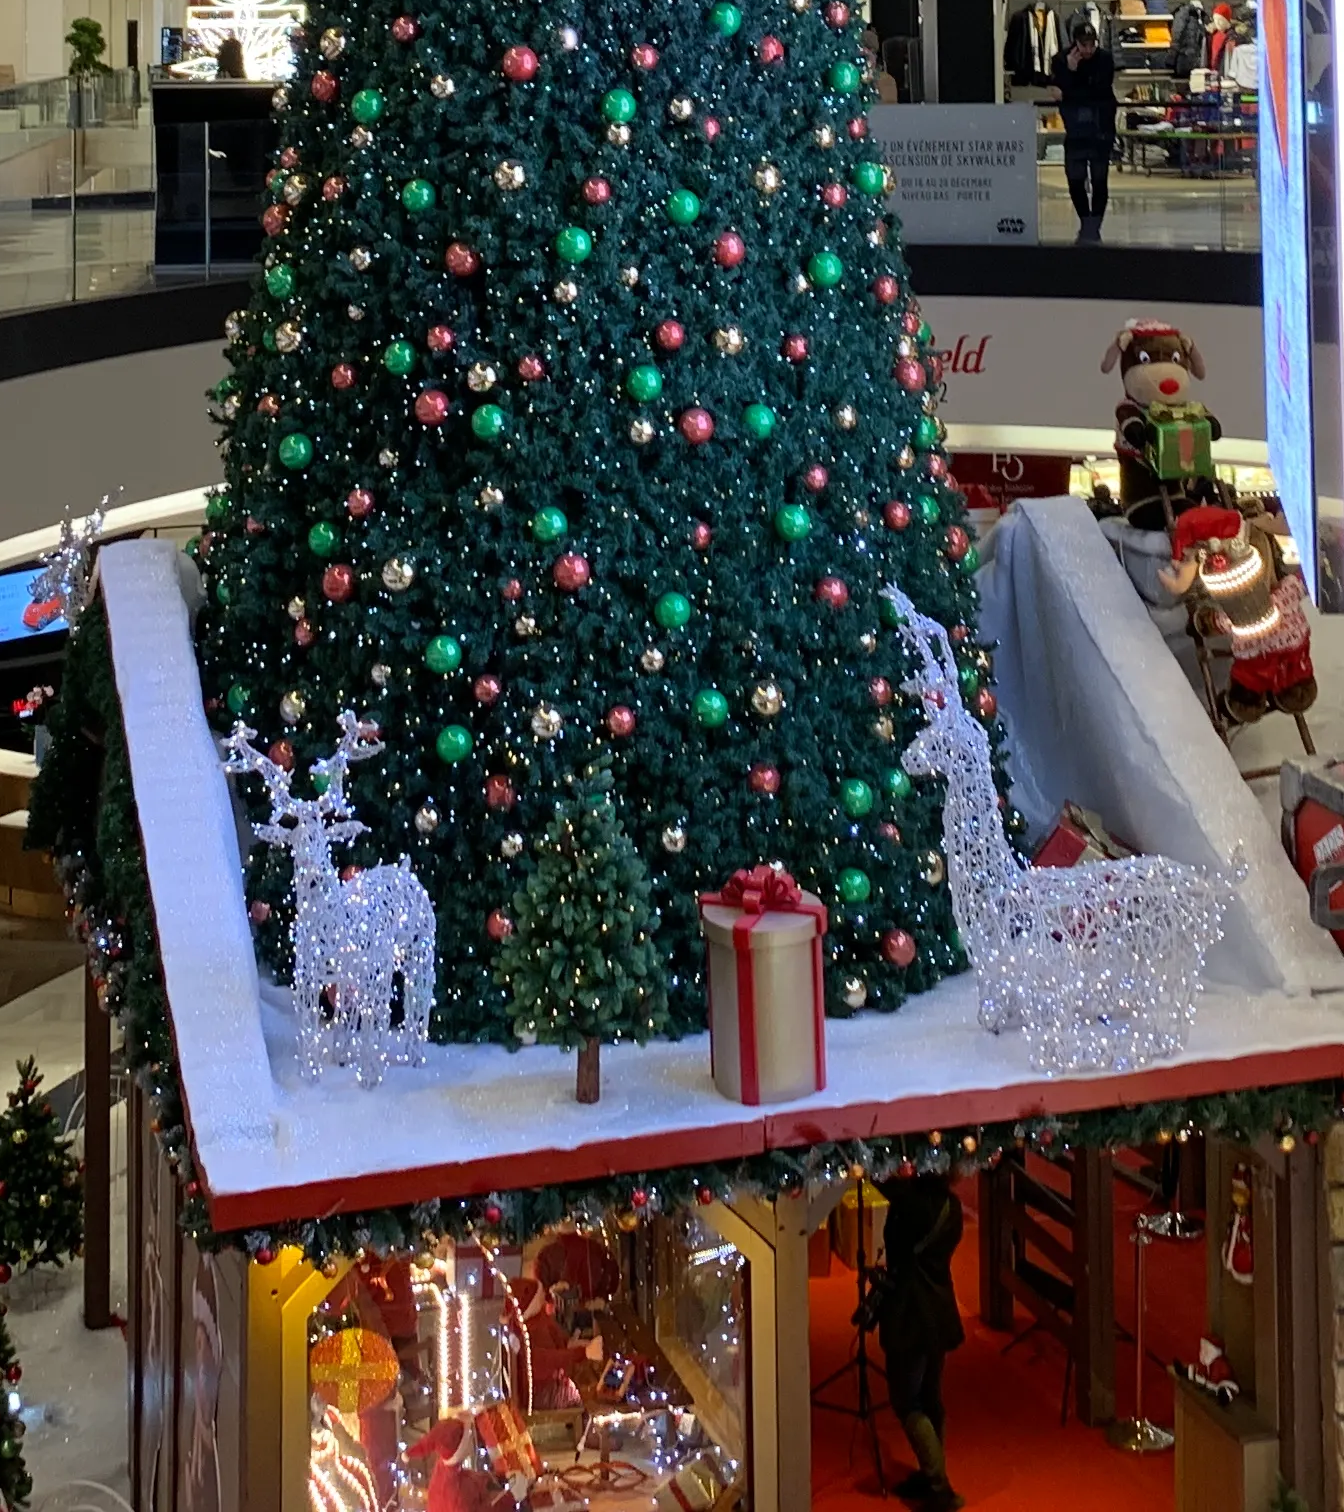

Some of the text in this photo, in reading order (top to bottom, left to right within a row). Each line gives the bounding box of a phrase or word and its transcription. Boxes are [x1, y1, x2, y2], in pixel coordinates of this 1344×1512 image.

[968, 141, 993, 153] STAR
[995, 141, 1024, 153] WARS
[956, 154, 1016, 167] SKYWALKER
